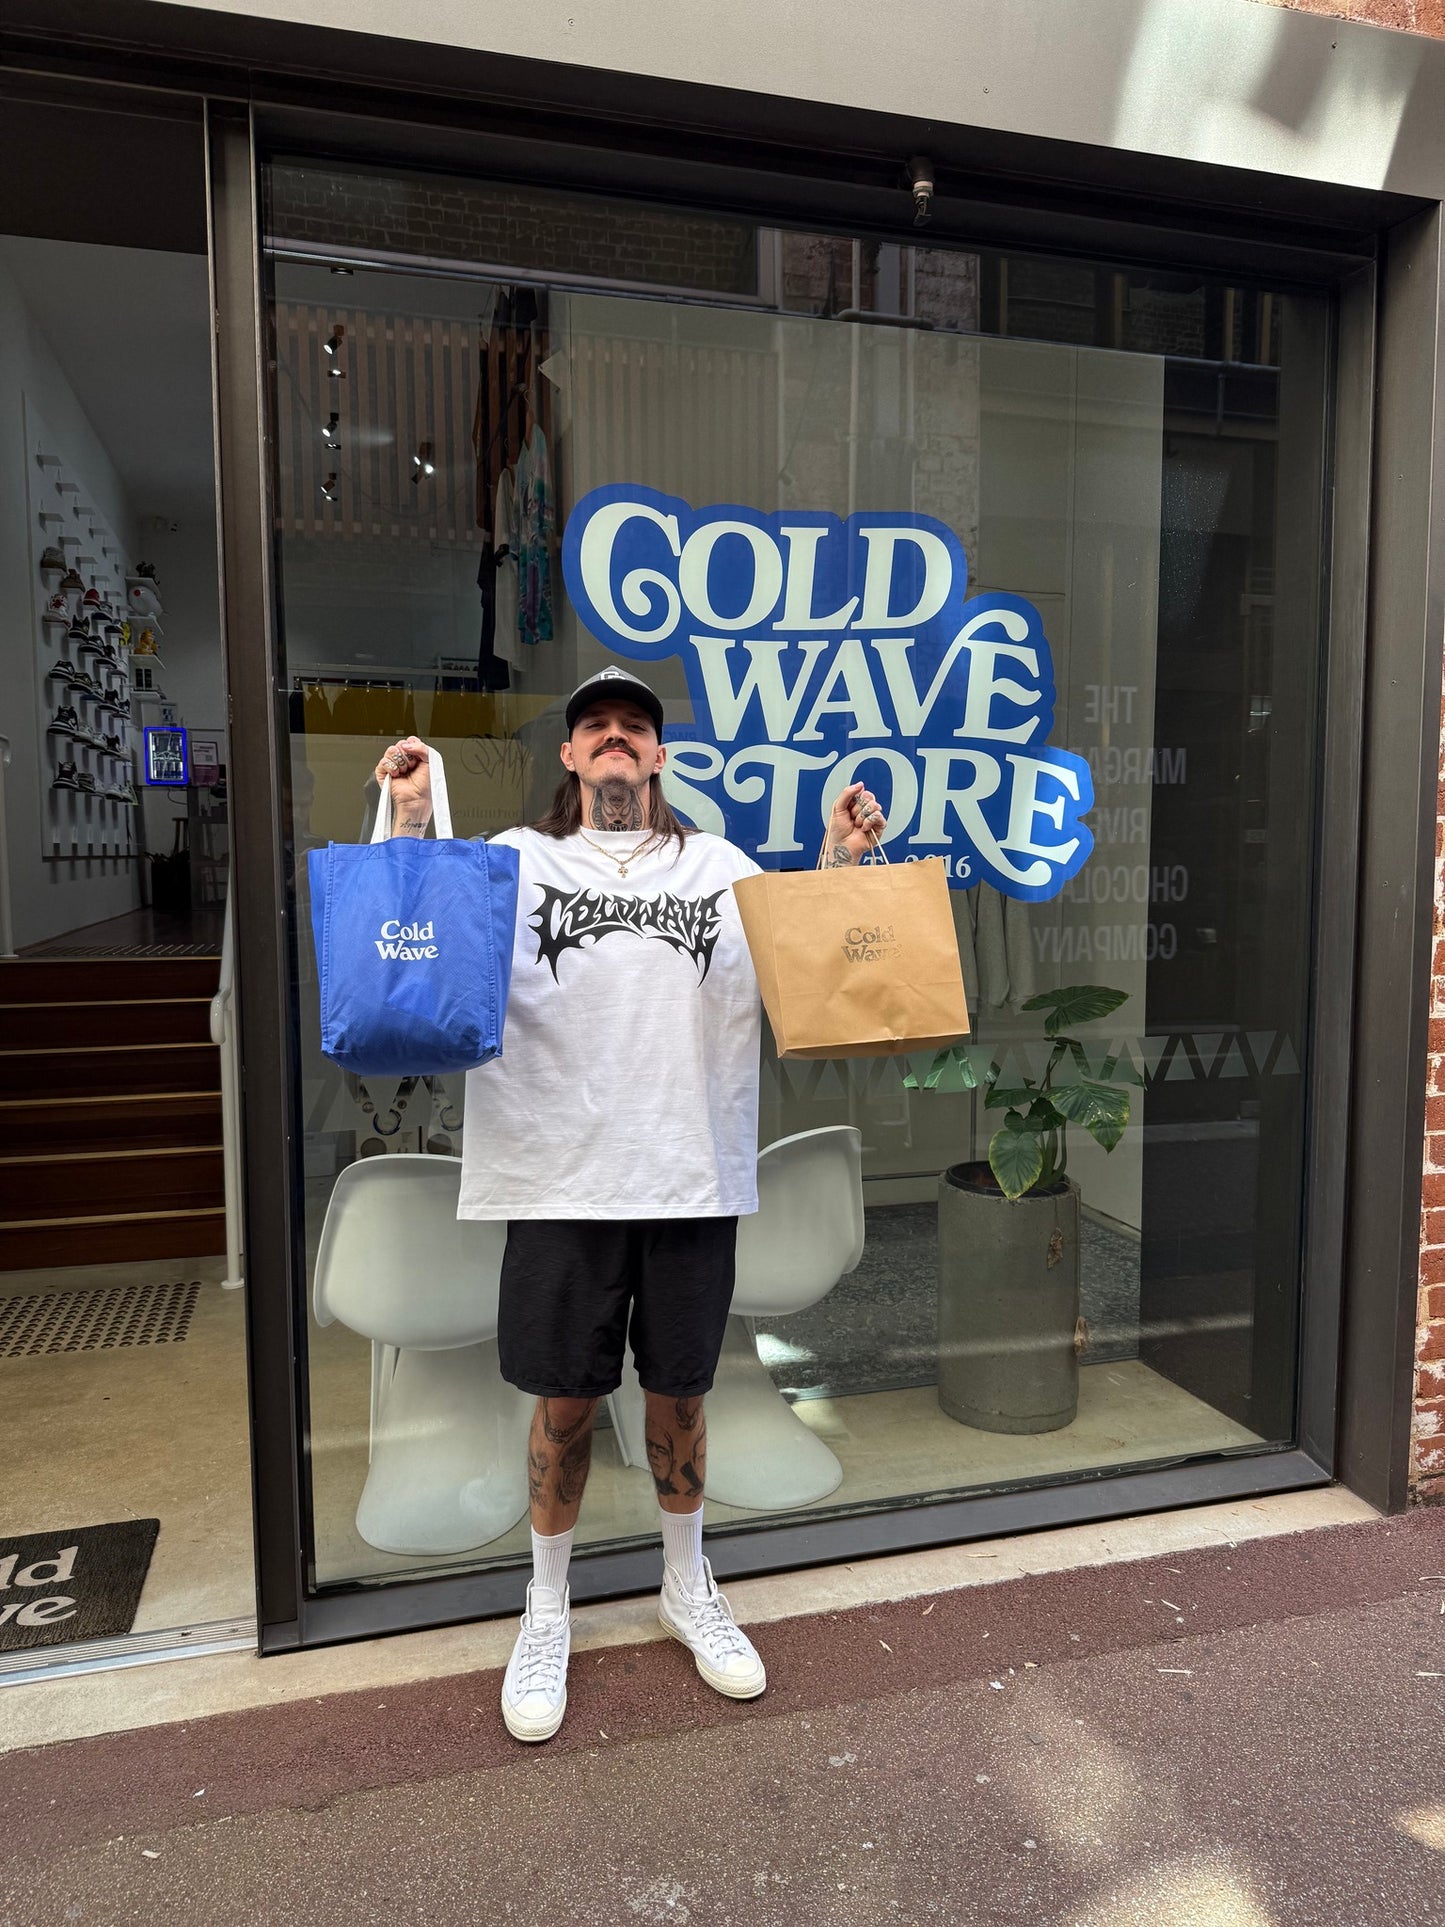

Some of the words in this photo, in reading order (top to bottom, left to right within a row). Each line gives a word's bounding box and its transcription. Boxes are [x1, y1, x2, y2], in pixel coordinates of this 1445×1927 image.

[580, 501, 953, 643] COLD
[689, 609, 1043, 745] WAVE
[660, 740, 1081, 888] STORE
[380, 919, 436, 941] Cold
[845, 925, 896, 945] Cold
[374, 940, 440, 961] Wave
[841, 944, 902, 963] Wave
